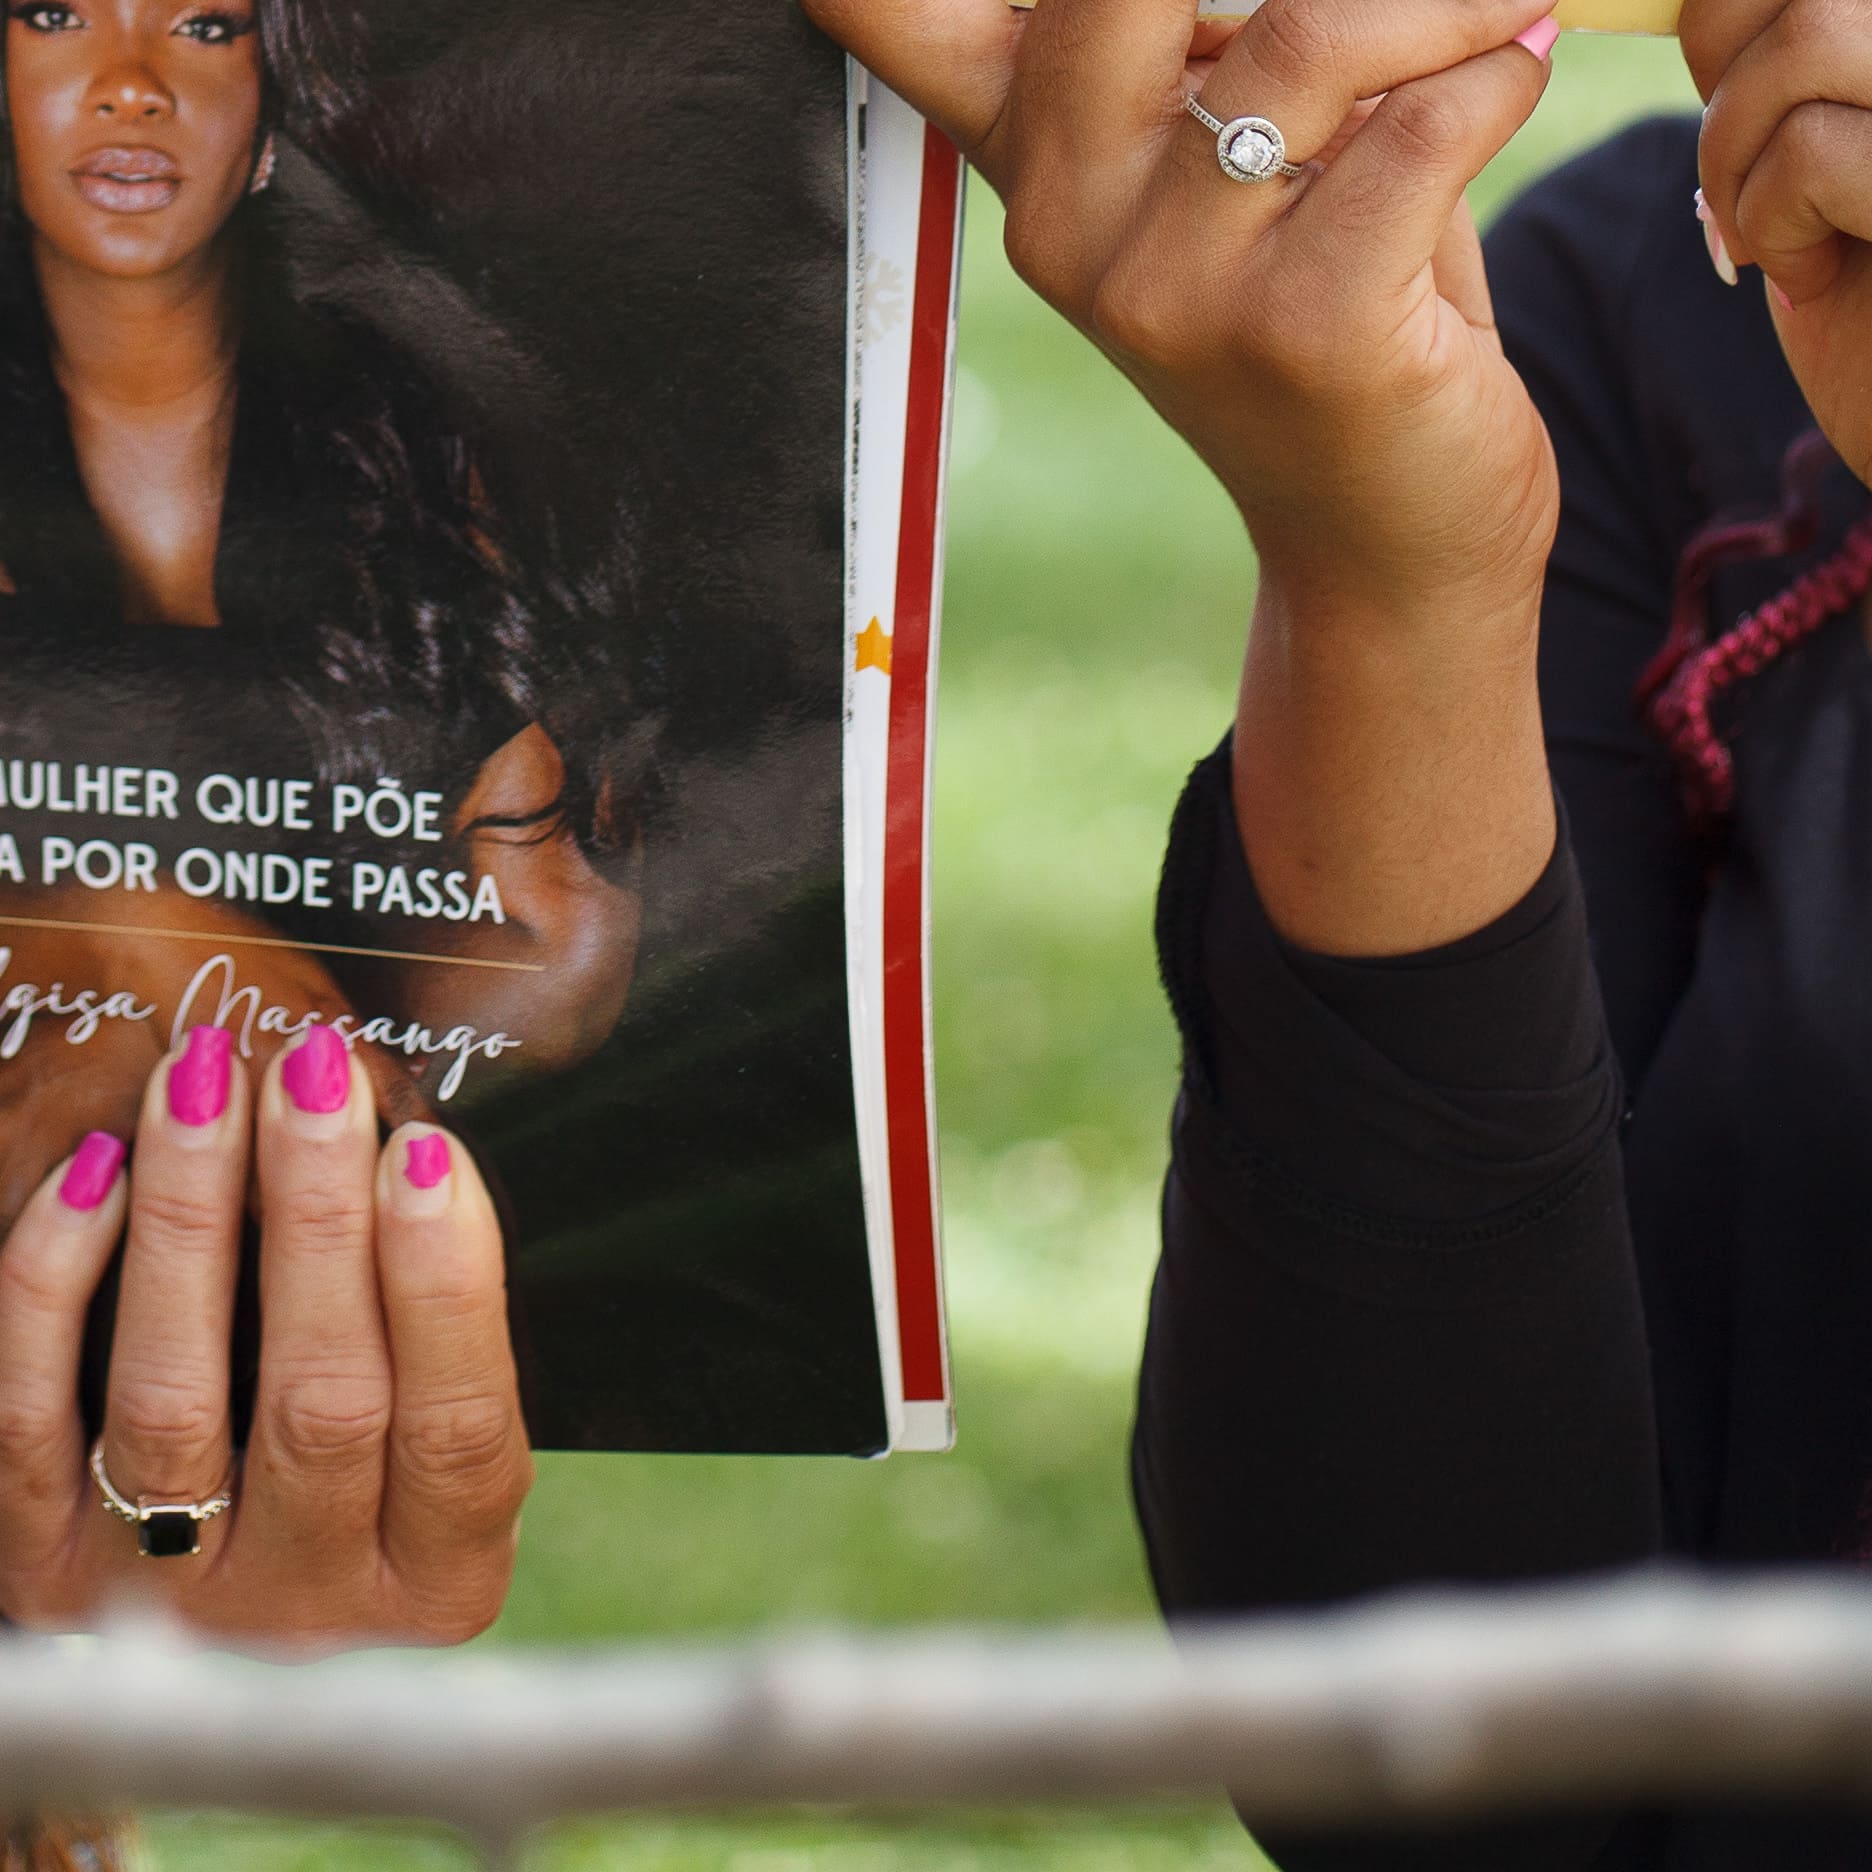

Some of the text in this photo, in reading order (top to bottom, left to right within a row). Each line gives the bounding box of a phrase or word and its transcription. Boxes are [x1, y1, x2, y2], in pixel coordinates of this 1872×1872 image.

[196, 774, 312, 830] QUE
[334, 777, 443, 841] PÕE
[43, 837, 157, 892] POR
[175, 847, 332, 907] ONDE
[353, 862, 505, 924] PASSA
